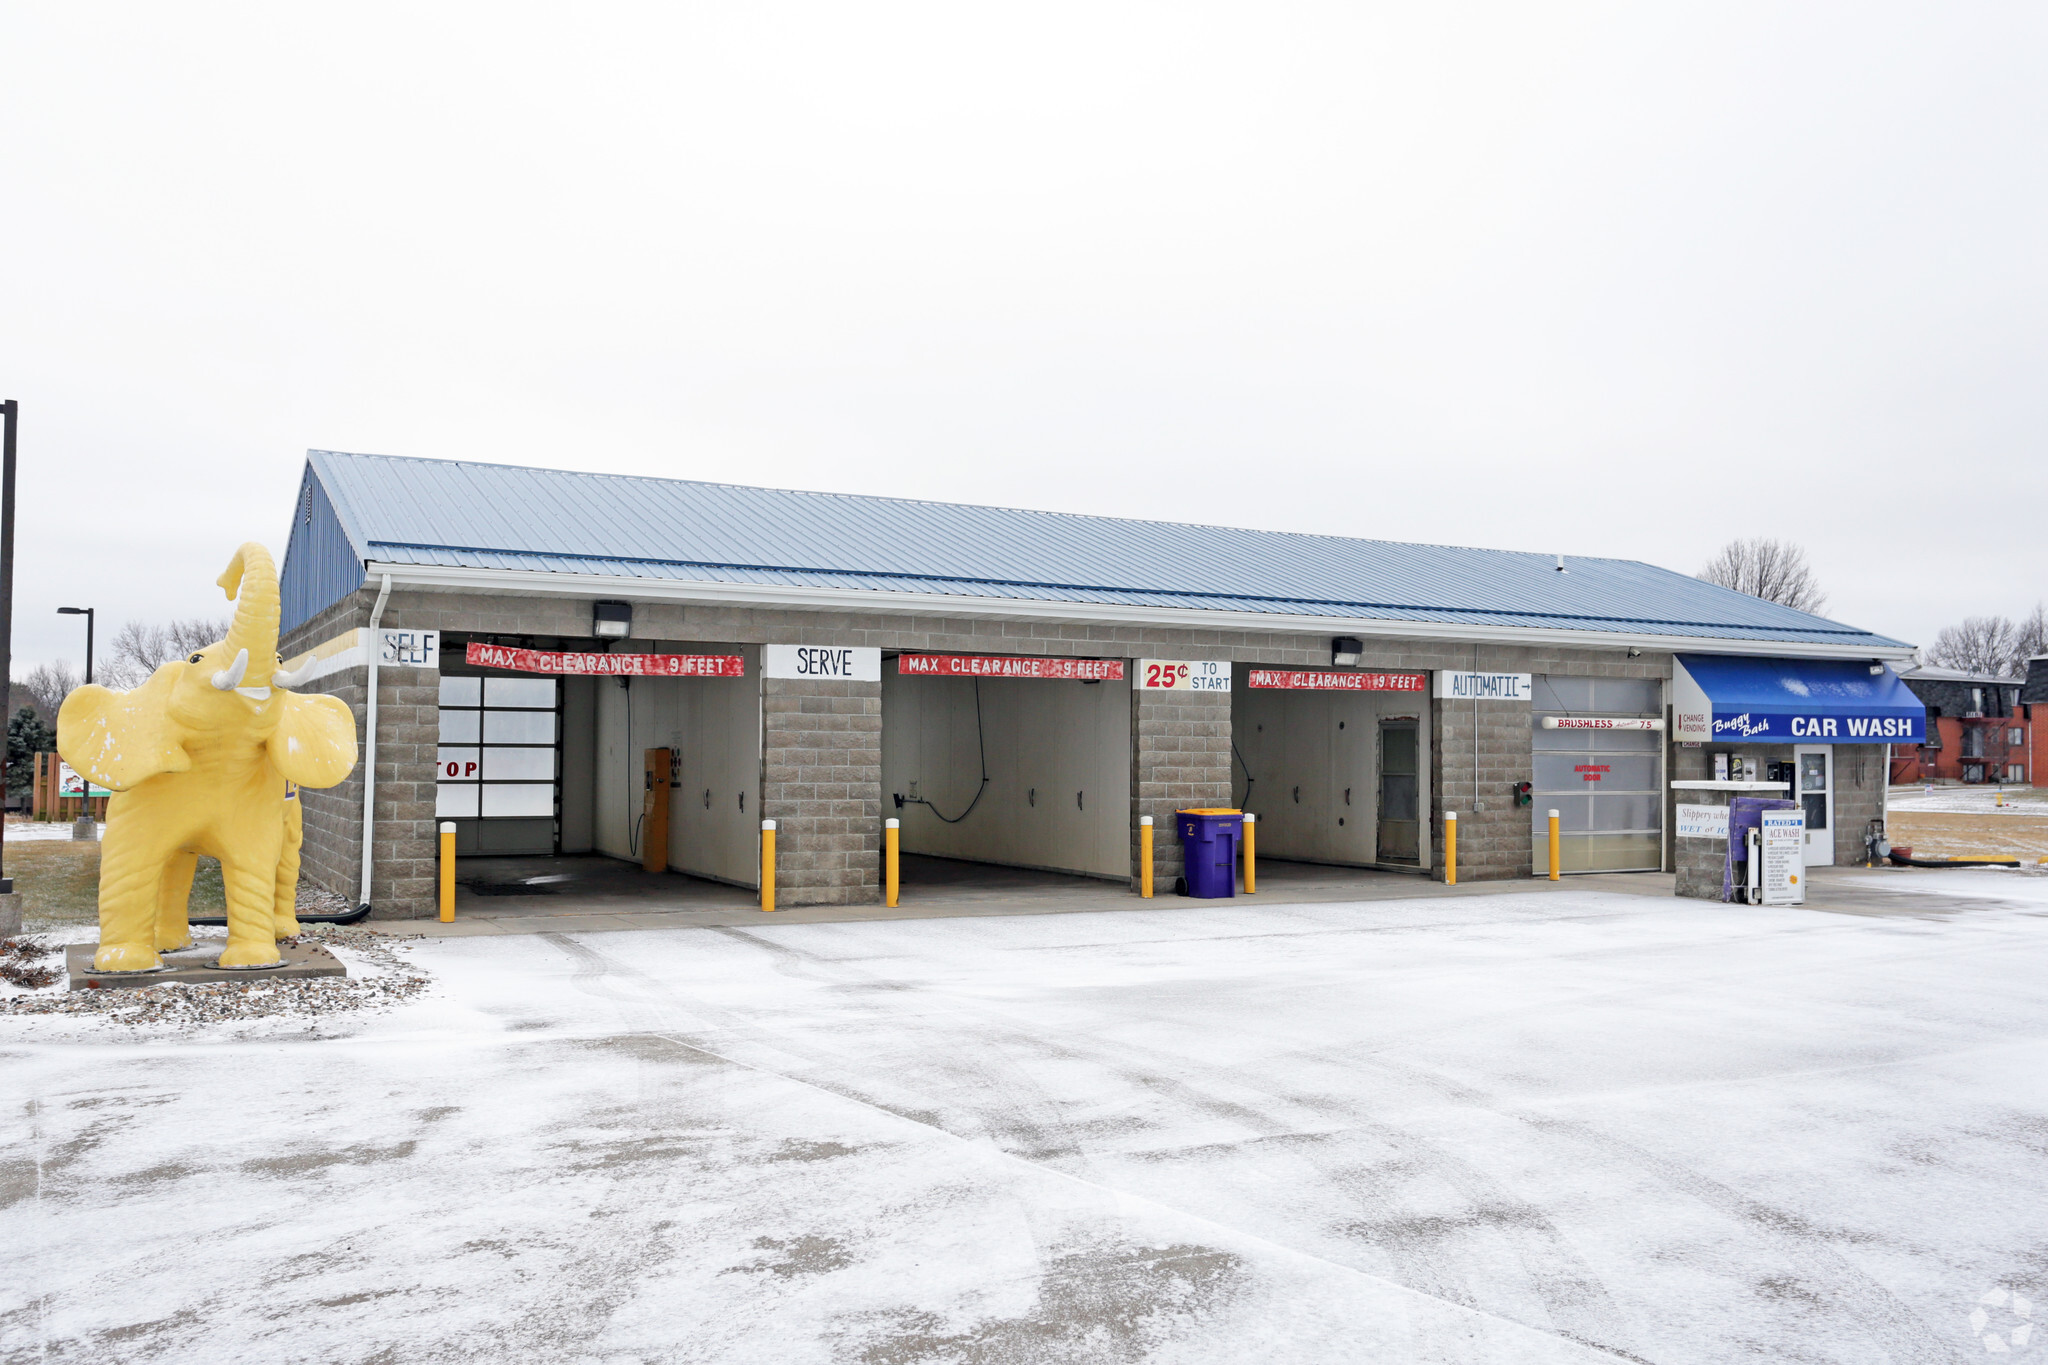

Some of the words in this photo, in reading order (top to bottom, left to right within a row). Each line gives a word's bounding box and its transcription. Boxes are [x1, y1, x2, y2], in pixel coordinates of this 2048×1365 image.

[383, 633, 434, 663] SELF
[480, 647, 518, 667] MAX
[539, 655, 644, 673] CLEARANCE
[669, 657, 679, 673] 9
[686, 658, 725, 674] FEET
[797, 647, 852, 676] SERVE
[908, 657, 939, 672] MAX
[951, 658, 1040, 675] CLEARANCE
[1063, 662, 1072, 676] 9
[1076, 662, 1110, 677] FEET
[1202, 662, 1217, 675] TO
[1192, 677, 1230, 690] START
[1255, 672, 1281, 686] MAX
[1293, 673, 1363, 688] CLEARANCE
[1378, 675, 1386, 688] 9
[1390, 675, 1418, 690] FEET
[1452, 674, 1520, 698] AUTOMATIC
[1558, 719, 1613, 729] BRUSHLESS
[1683, 714, 1704, 722] CHANGE
[1712, 713, 1750, 732] Buggy
[1791, 717, 1838, 737] CAR
[1847, 718, 1912, 737] WASH
[1683, 724, 1706, 732] VENDING
[1739, 718, 1770, 737] Bath
[436, 762, 477, 777] OP
[1682, 808, 1712, 821] Slippery
[1783, 828, 1800, 838] WASH
